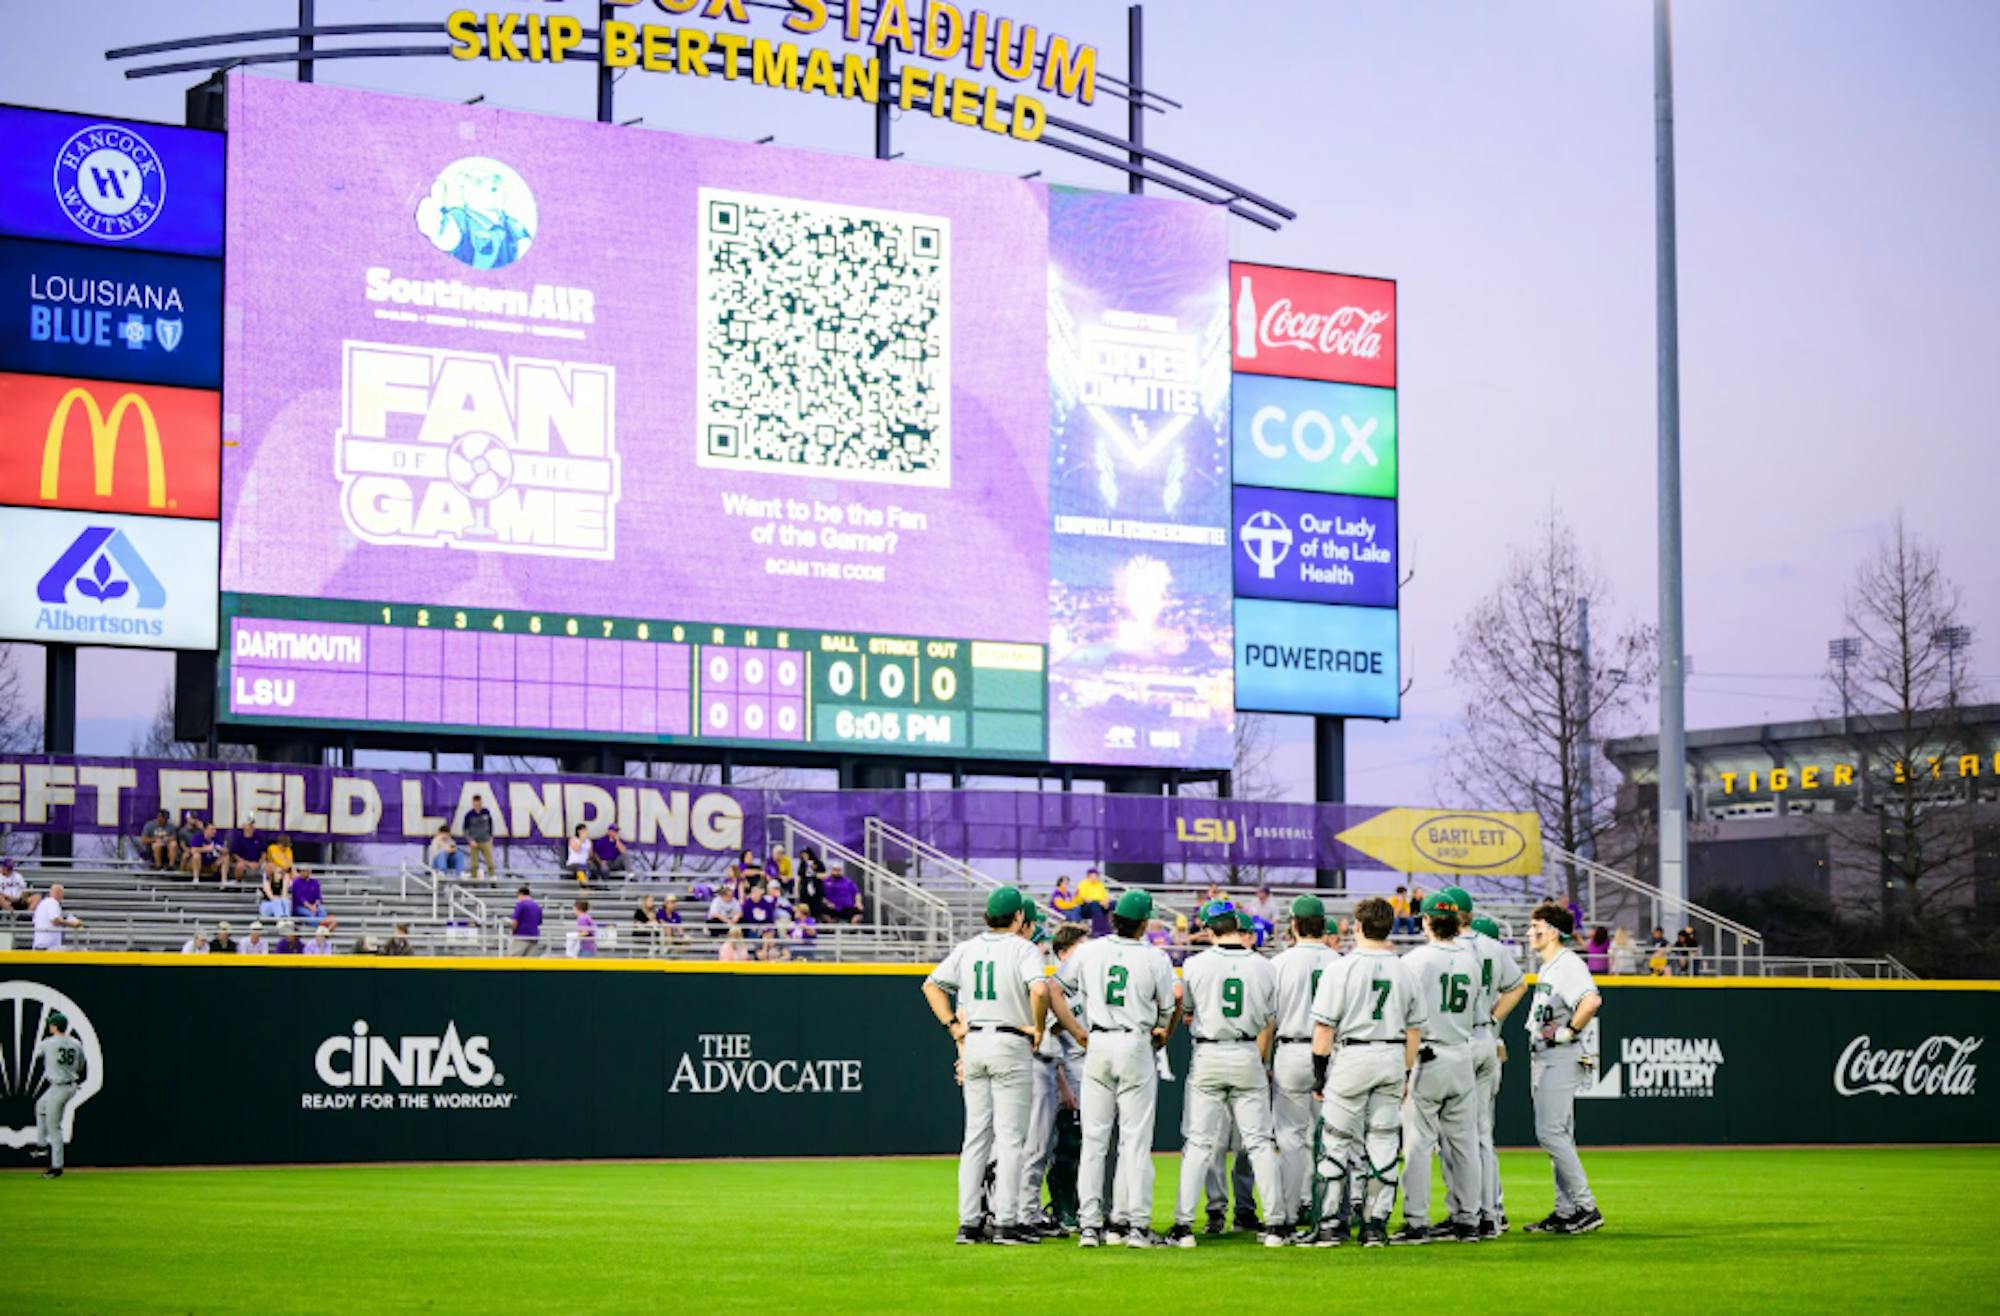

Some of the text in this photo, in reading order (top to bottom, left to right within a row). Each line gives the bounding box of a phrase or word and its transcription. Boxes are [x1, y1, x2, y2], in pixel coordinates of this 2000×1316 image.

[782, 0, 1098, 106] STADIUM
[447, 9, 1047, 142] SKIP BERTMAN FIELD
[62, 131, 157, 177] HANCOCK
[62, 186, 156, 233] WHITNEY
[30, 273, 184, 312] LOUISIANA
[30, 304, 112, 347] BLUE
[1259, 298, 1390, 358] Coca-Cola
[344, 341, 612, 454] FAN
[1251, 405, 1378, 467] COX
[392, 450, 426, 469] OF
[344, 475, 612, 555] GAME
[721, 492, 927, 531] Want to be the Fan
[1300, 513, 1376, 542] Our Lady
[751, 523, 898, 555] of the Game?
[1300, 538, 1391, 564] of the Lake
[765, 558, 886, 583] SCAN THE CODE
[1300, 563, 1354, 586] Health
[35, 607, 163, 637] Albertsons
[381, 606, 392, 625] 1
[417, 608, 430, 627] 2
[455, 611, 467, 629] 3
[492, 613, 505, 632] 4
[529, 616, 542, 634] 5
[566, 618, 579, 636] 6
[602, 620, 613, 638] 7
[637, 622, 649, 641] 8
[672, 624, 685, 643] 9
[711, 627, 725, 645] R
[777, 631, 789, 649] E
[236, 629, 797, 687] DARTMOUTH 0 0 0
[820, 634, 858, 653] BALL
[868, 637, 919, 657] STRIKE
[926, 641, 957, 660] OUT
[1246, 644, 1383, 674] POWERADE
[828, 660, 957, 702] 0 0 0
[236, 676, 797, 732] LSU 0 0 0
[835, 710, 951, 743] 6:05 PM
[1720, 764, 1853, 795] TIGER
[159, 768, 382, 835] FIELD
[402, 779, 743, 850] LANDING
[1176, 816, 1315, 844] LSU BASEBALL
[1429, 827, 1506, 847] BARTLETT
[973, 960, 997, 1001] 11
[1106, 965, 1129, 1007] 2
[1222, 978, 1244, 1018] 9
[1372, 979, 1392, 1020] 7
[1440, 973, 1470, 1014] 16
[698, 1034, 752, 1058] THE
[1621, 1037, 1725, 1064] LOUISIANA
[1834, 1034, 1985, 1096] Coca-Cola
[667, 1051, 863, 1093] ADVOCATE
[1629, 1062, 1717, 1088] LOTTERY
[302, 1093, 513, 1109] READY FOR THE WORKDAY
[1628, 1087, 1714, 1098] CORPORATION
